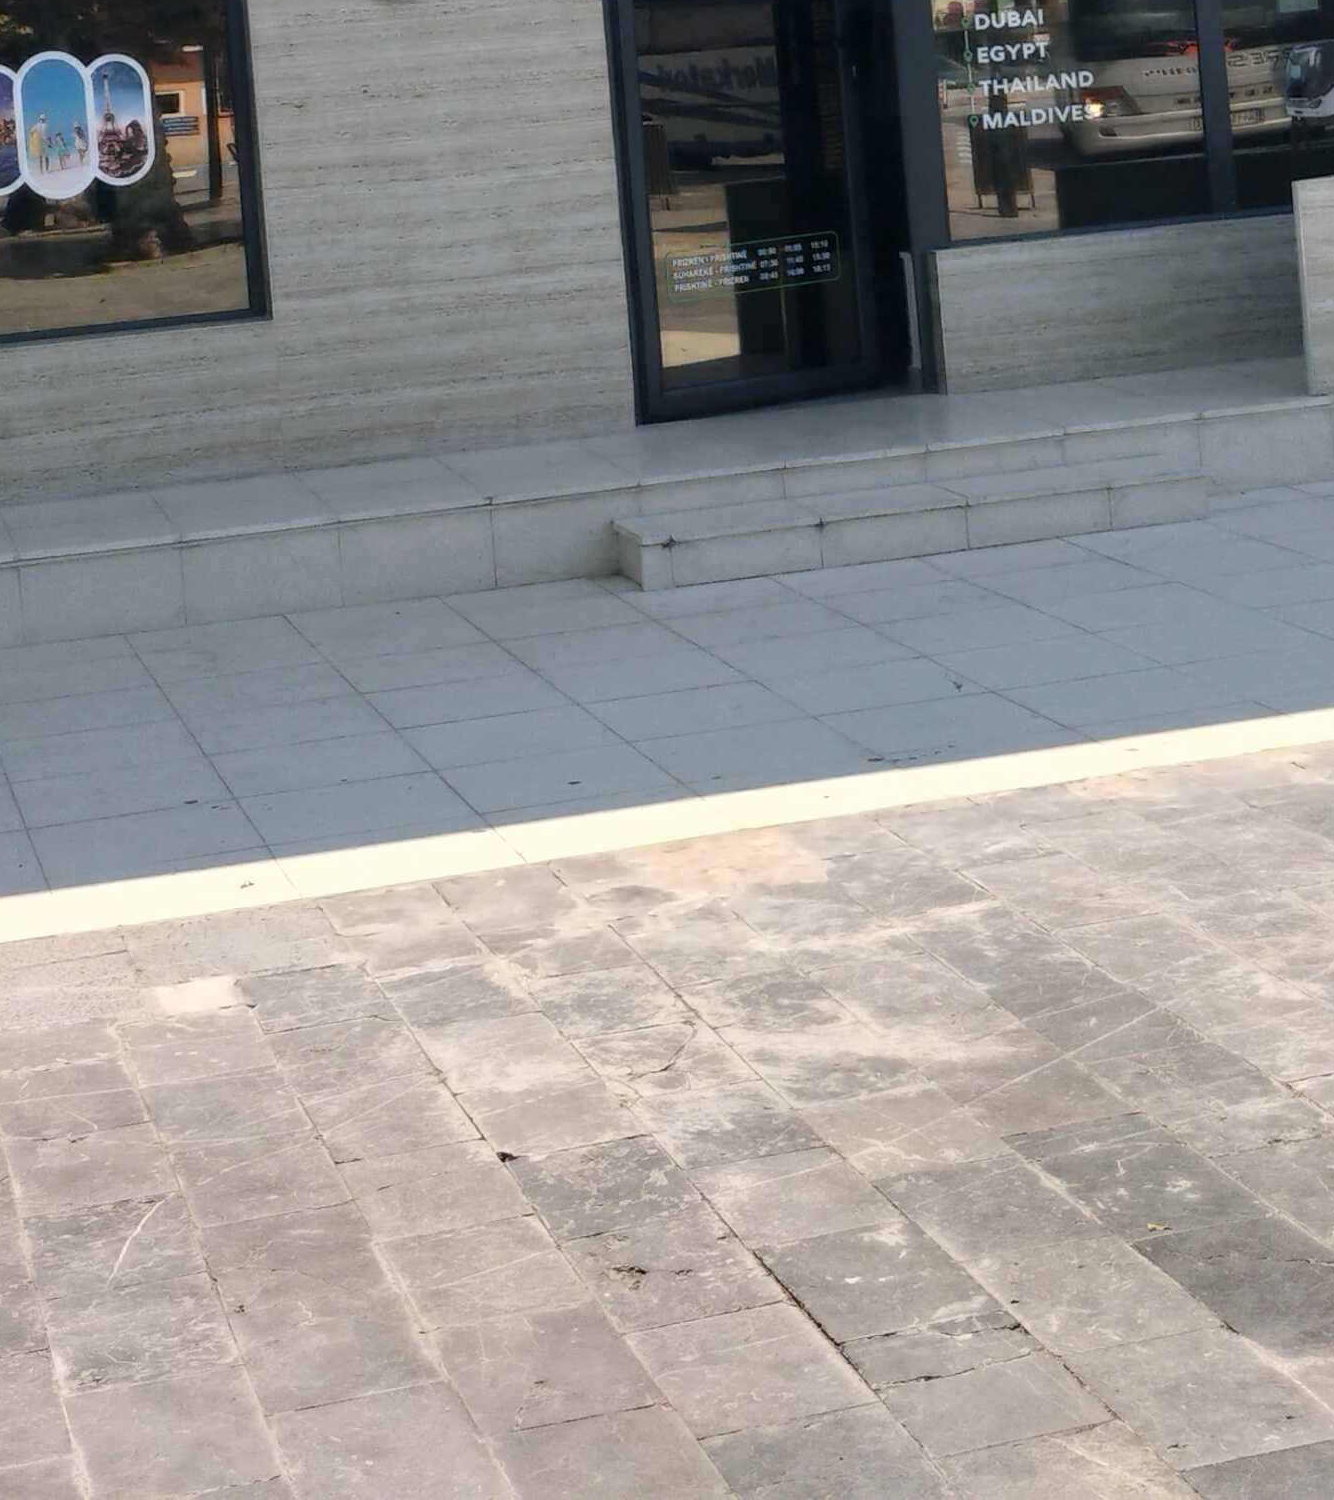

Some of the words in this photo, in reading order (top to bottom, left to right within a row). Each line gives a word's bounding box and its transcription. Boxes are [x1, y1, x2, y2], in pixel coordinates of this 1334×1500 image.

[975, 9, 1044, 30] DUBAI
[977, 42, 1048, 63] EGYPT
[979, 71, 1093, 96] THAILAND
[983, 104, 1095, 130] MALDIVES
